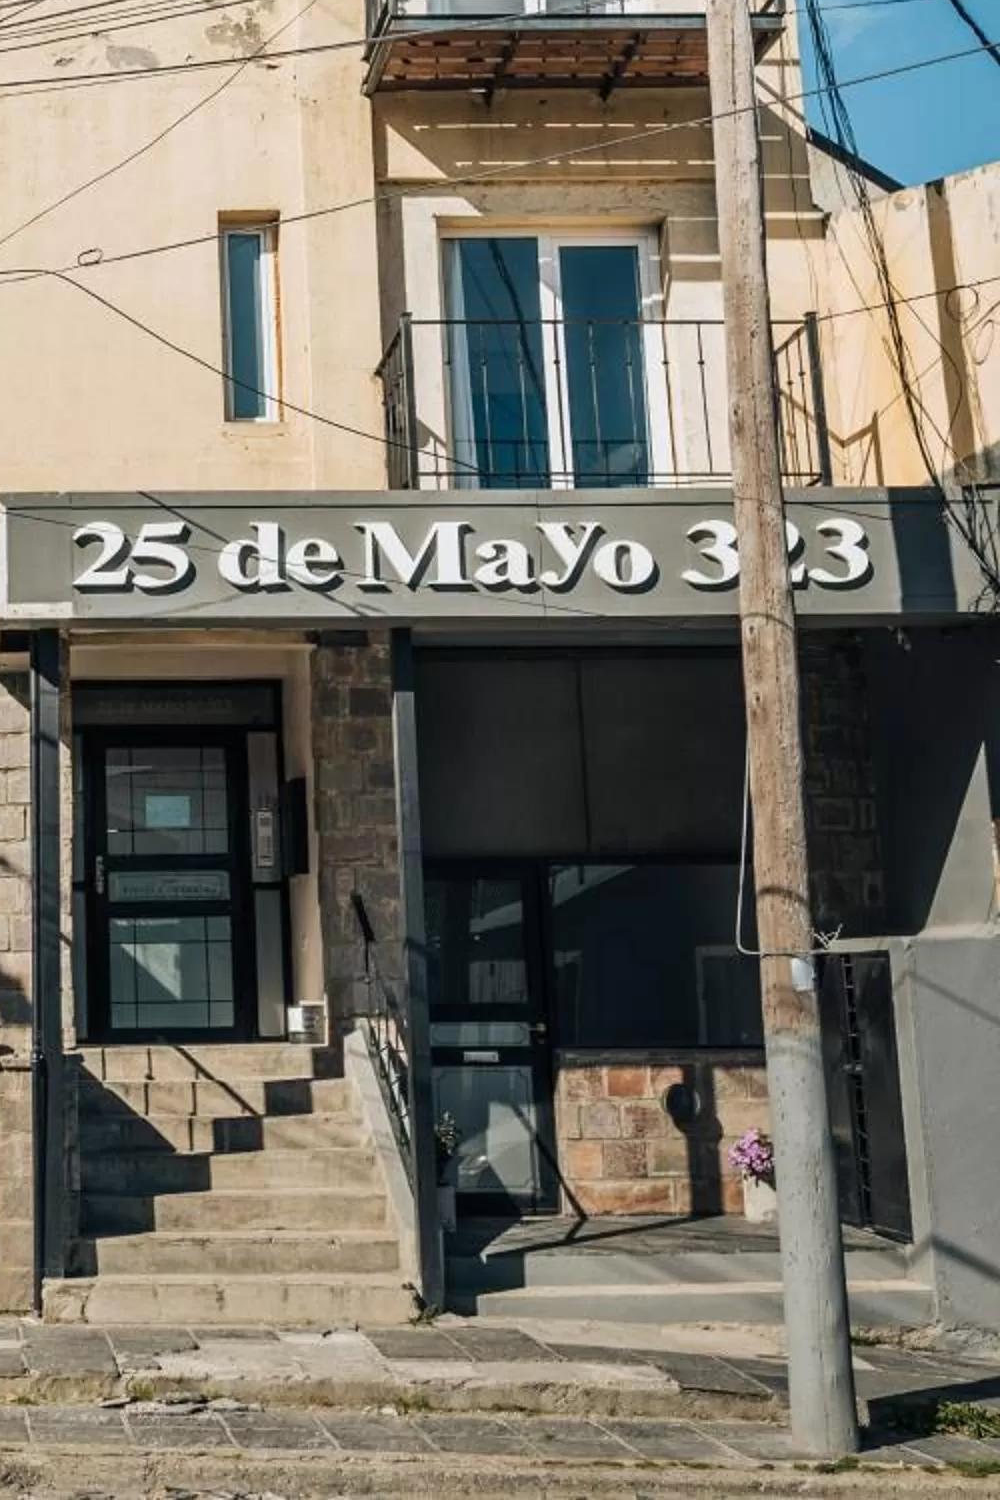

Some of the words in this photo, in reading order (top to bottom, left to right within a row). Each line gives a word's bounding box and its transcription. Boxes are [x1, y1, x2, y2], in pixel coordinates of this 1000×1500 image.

[72, 520, 196, 596] 25
[218, 520, 344, 594] de
[353, 520, 659, 595] Mayo
